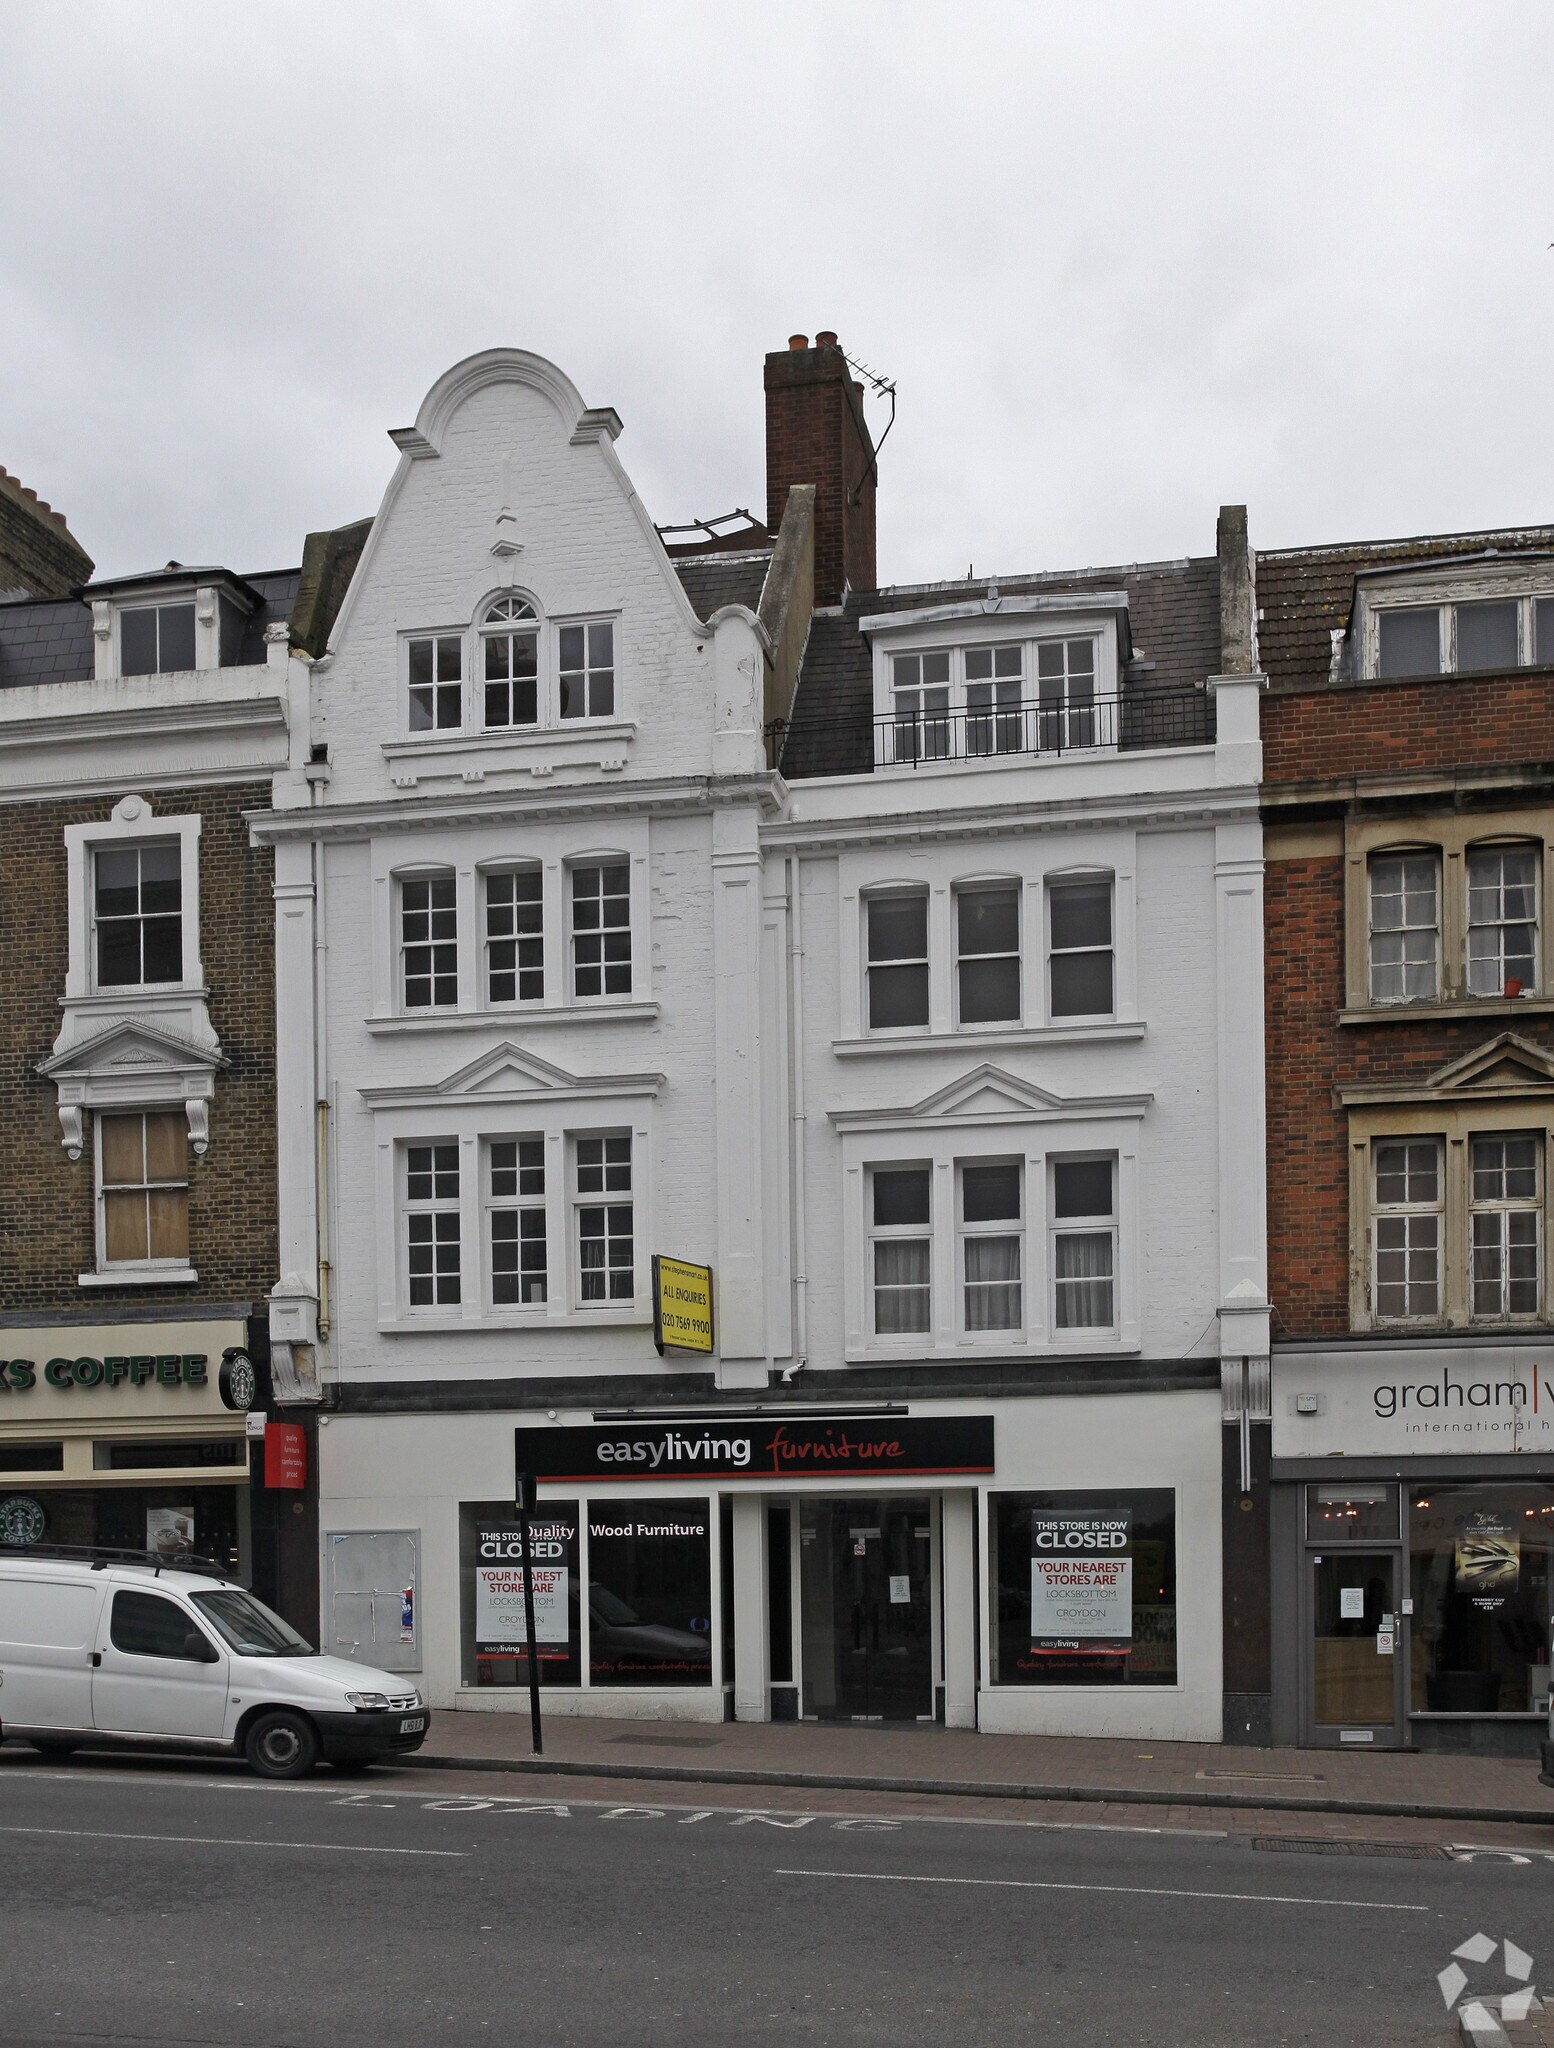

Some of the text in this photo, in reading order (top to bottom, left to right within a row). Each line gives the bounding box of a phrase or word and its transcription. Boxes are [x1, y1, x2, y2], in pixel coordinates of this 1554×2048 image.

[663, 1285, 706, 1305] ALL ENQUIRIES
[662, 1312, 709, 1334] 020 7569 9900
[44, 1354, 207, 1387] COFFEE
[1405, 1420, 1531, 1433] international
[597, 1426, 906, 1472] easyliving furniture
[589, 1524, 632, 1537] Wood
[637, 1523, 704, 1536] Furniture
[1036, 1521, 1127, 1531] THIS STORE IS NOW
[4, 1532, 37, 1543] COFFEE
[480, 1532, 501, 1541] THIS
[502, 1532, 522, 1541] STO
[1036, 1531, 1127, 1549] CLOSED
[1036, 1562, 1127, 1573] YOUR NEAREST
[481, 1571, 563, 1581] YOUR NAREST
[1045, 1574, 1116, 1585] STORES ARE
[489, 1583, 554, 1593] STORE ARE
[1046, 1590, 1117, 1599] LOCKSBOTTOM
[1056, 1608, 1107, 1618] CROYDON
[484, 1645, 520, 1654] easyliving
[1040, 1639, 1079, 1649] easyliving
[326, 1794, 903, 1832] LOADING
